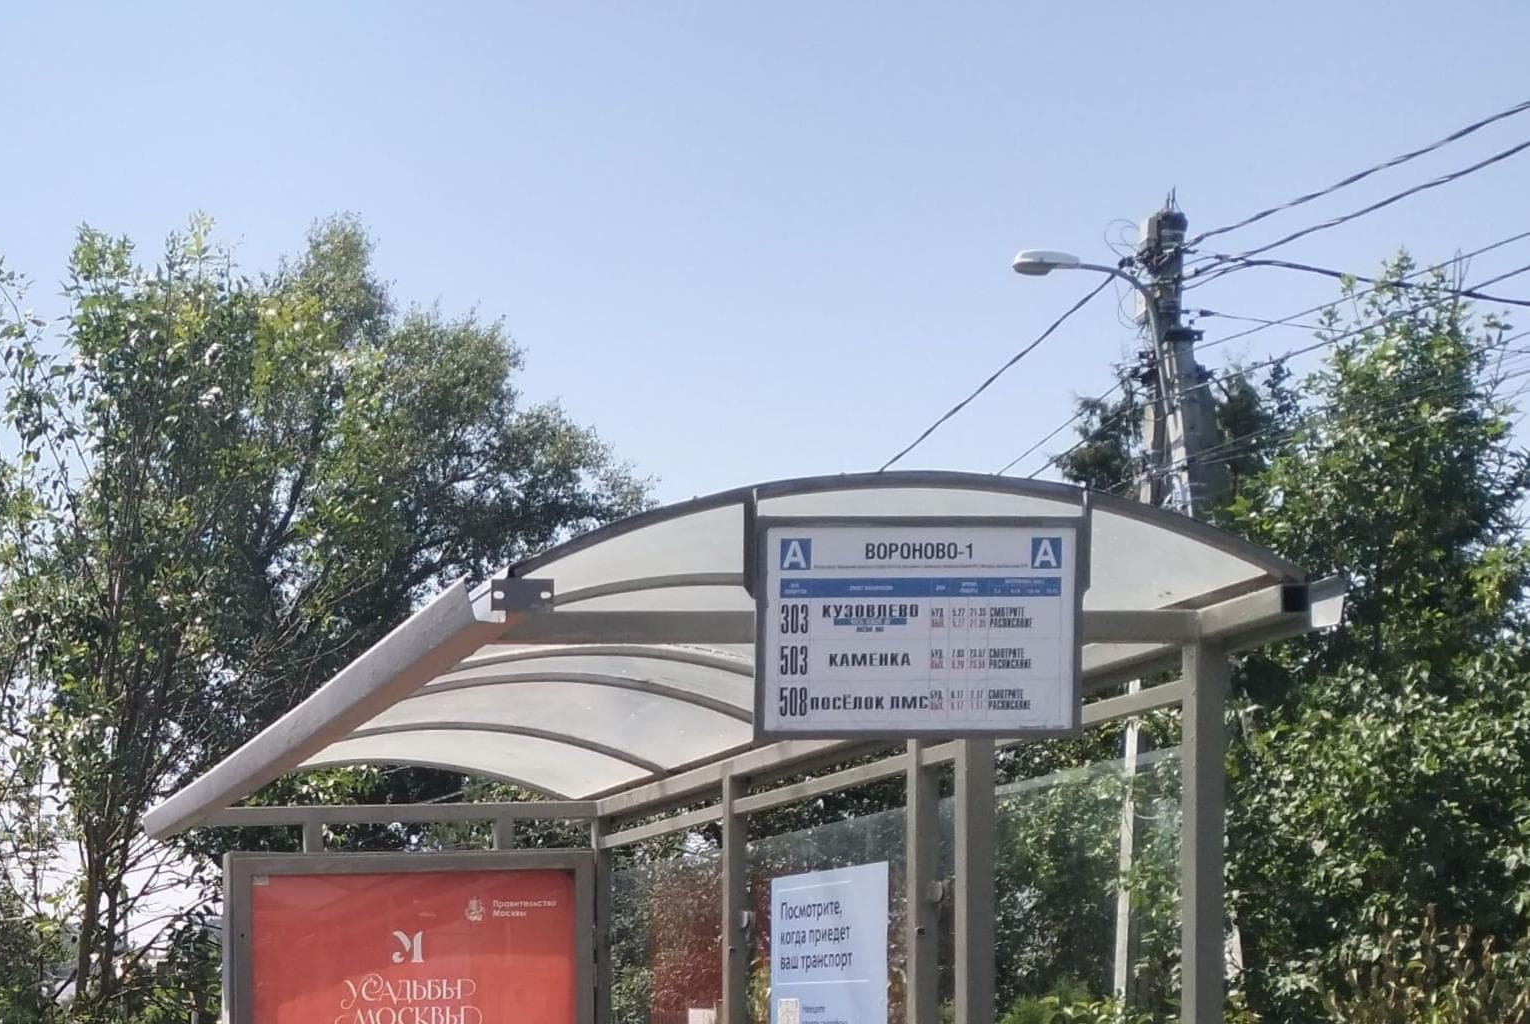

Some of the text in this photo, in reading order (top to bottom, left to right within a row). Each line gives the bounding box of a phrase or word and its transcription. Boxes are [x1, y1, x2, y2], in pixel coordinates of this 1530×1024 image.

[783, 540, 808, 569] А
[865, 543, 974, 560] ВОРОНОВО-1
[1033, 539, 1058, 568] А
[781, 604, 919, 634] 303 КУЗОВЛЕВО
[990, 607, 1025, 617] СМОТРИТЕ
[990, 618, 1032, 628] РАСПИСАНИЕ
[780, 645, 911, 675] 503 КАМЕНКА
[990, 648, 1024, 658] СМОТРИТЕ
[989, 659, 1031, 669] РАСПИСАНИЕ
[779, 687, 808, 717] 508
[810, 694, 885, 710] ПОСЁЛОК
[989, 689, 1024, 700] СМОТРИТЕ
[989, 700, 1030, 711] РАСПИСАНИЕ
[492, 899, 557, 908] Правительство
[780, 900, 843, 921] Посмотрите,
[492, 910, 527, 918] Москвы
[780, 925, 851, 947] когда приедет
[780, 951, 853, 973] ваш транспорт
[340, 973, 476, 1010] УСАДЬБЫ
